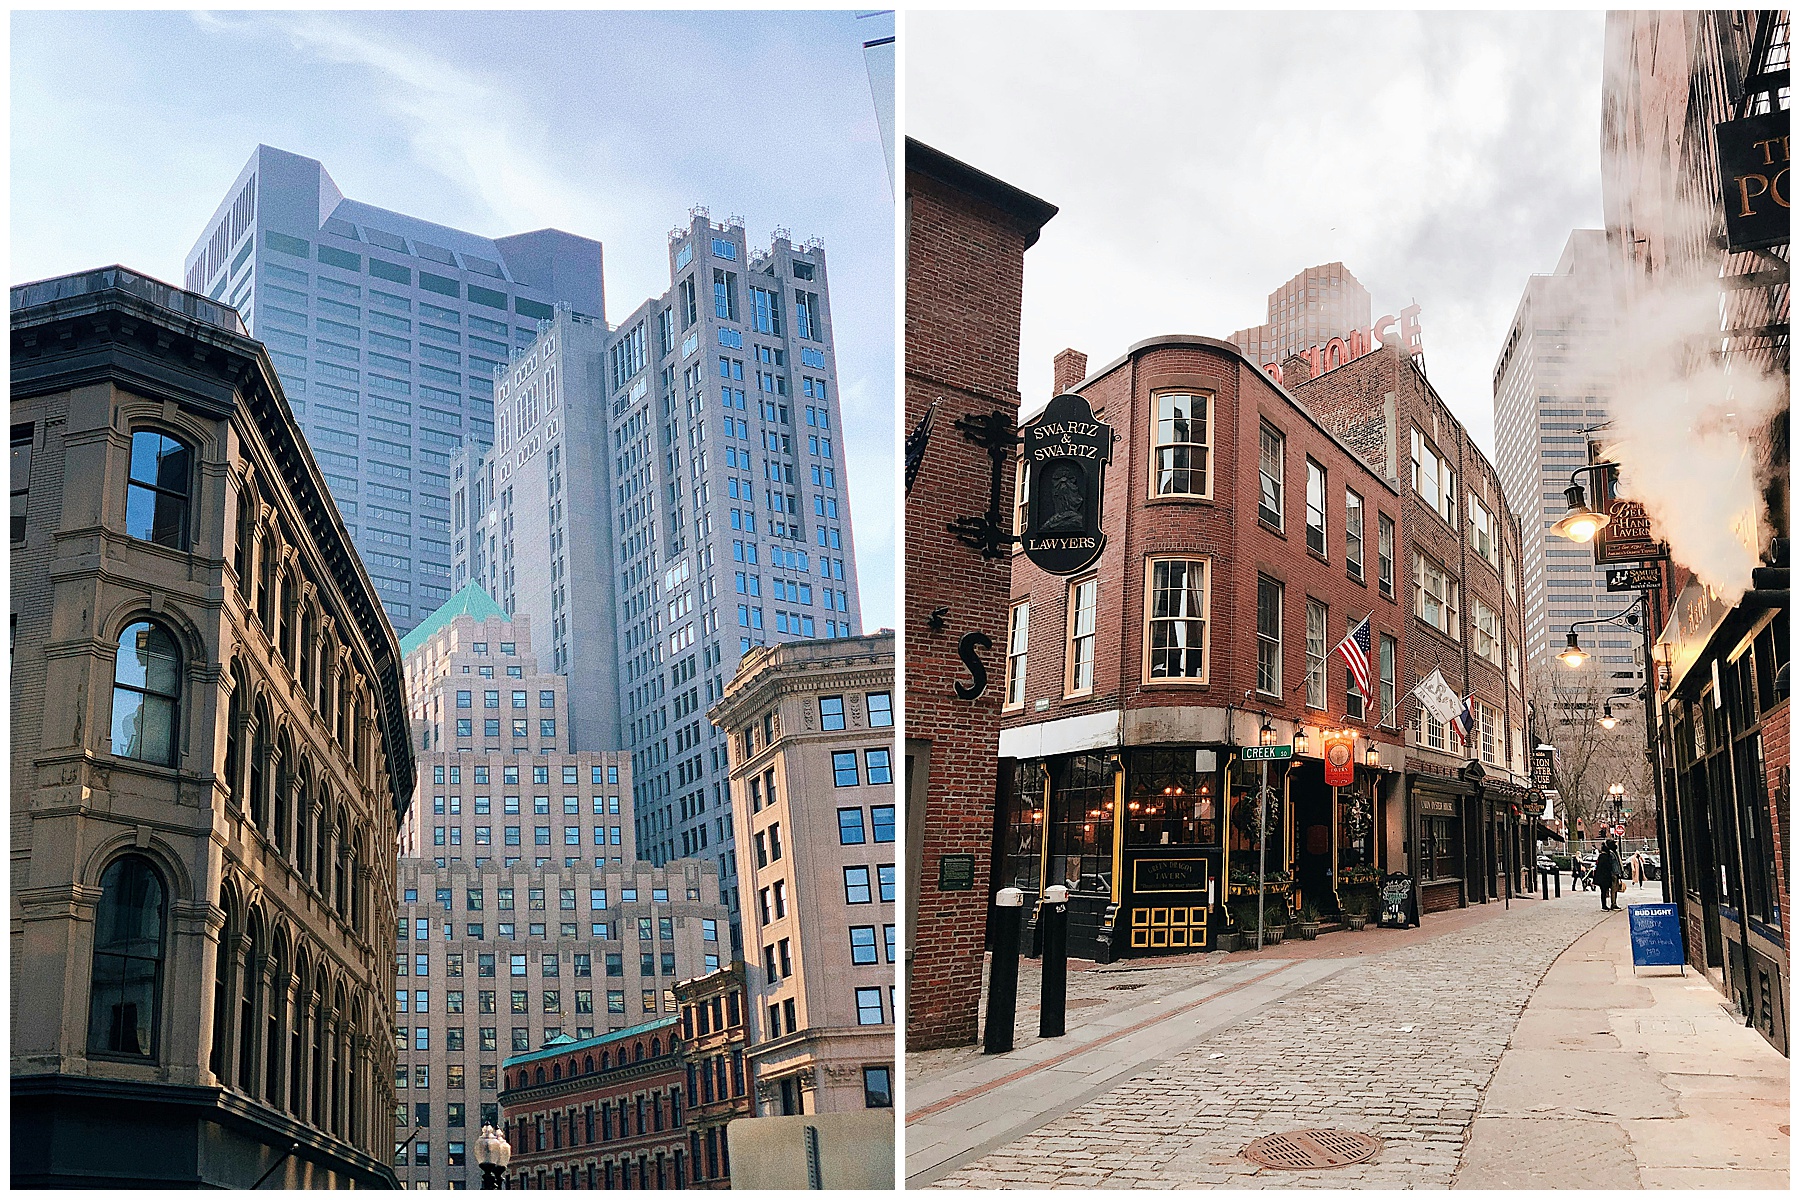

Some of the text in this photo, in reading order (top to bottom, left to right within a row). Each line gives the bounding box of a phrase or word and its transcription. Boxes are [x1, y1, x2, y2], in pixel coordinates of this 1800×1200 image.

[1033, 421, 1099, 440] SWARTZ
[1060, 433, 1071, 444] &
[1034, 443, 1098, 462] SWARTZ
[1620, 517, 1652, 529] HAND
[1609, 524, 1651, 537] TAVERN
[1029, 536, 1096, 551] LAWYERS
[1629, 568, 1660, 578] SAMUEL
[1632, 575, 1658, 583] ADAMS
[1246, 747, 1276, 758] CREEK
